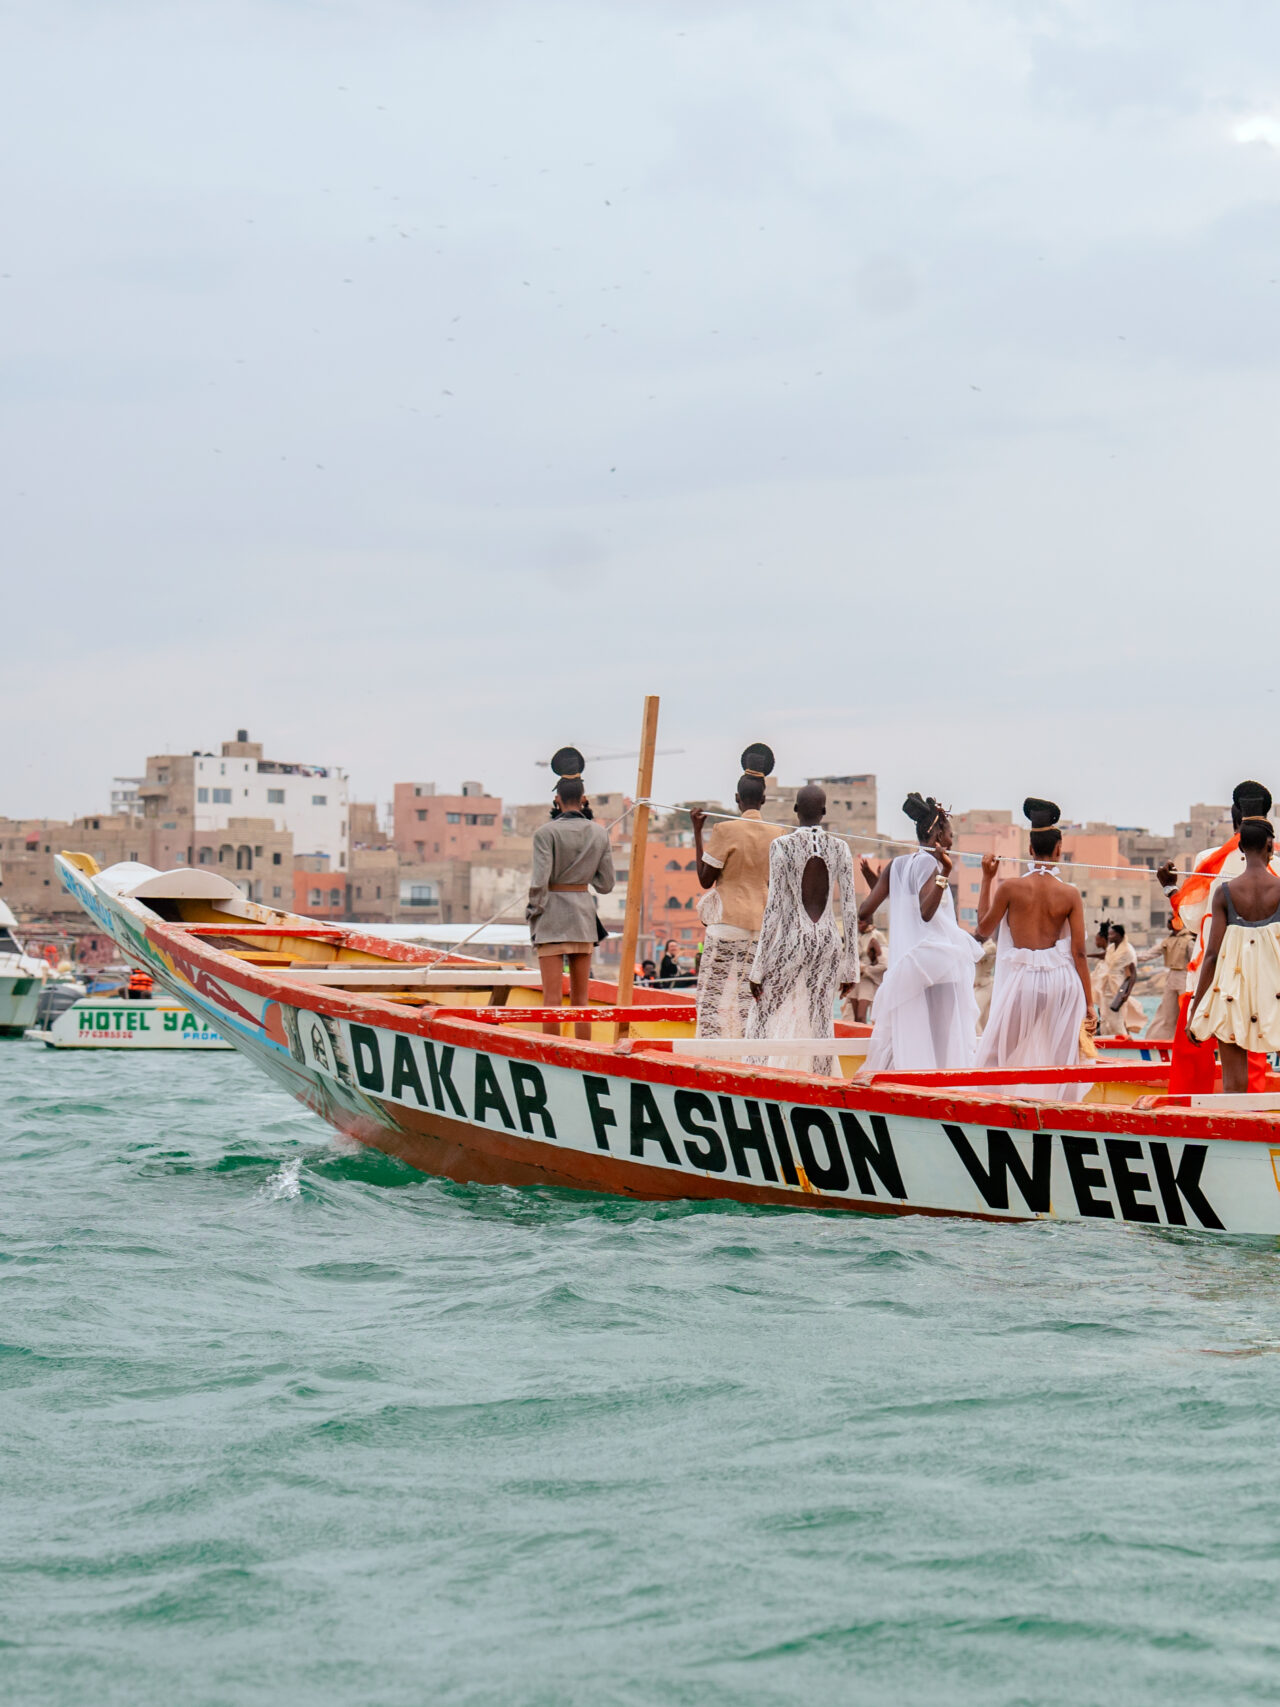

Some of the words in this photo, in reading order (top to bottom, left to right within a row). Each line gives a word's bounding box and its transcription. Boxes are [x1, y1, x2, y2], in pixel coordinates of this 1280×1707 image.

[79, 1011, 150, 1031] HOTEL
[349, 1023, 557, 1140] DAKAR
[582, 1073, 909, 1200] FASHION
[940, 1123, 1227, 1231] WEEK
